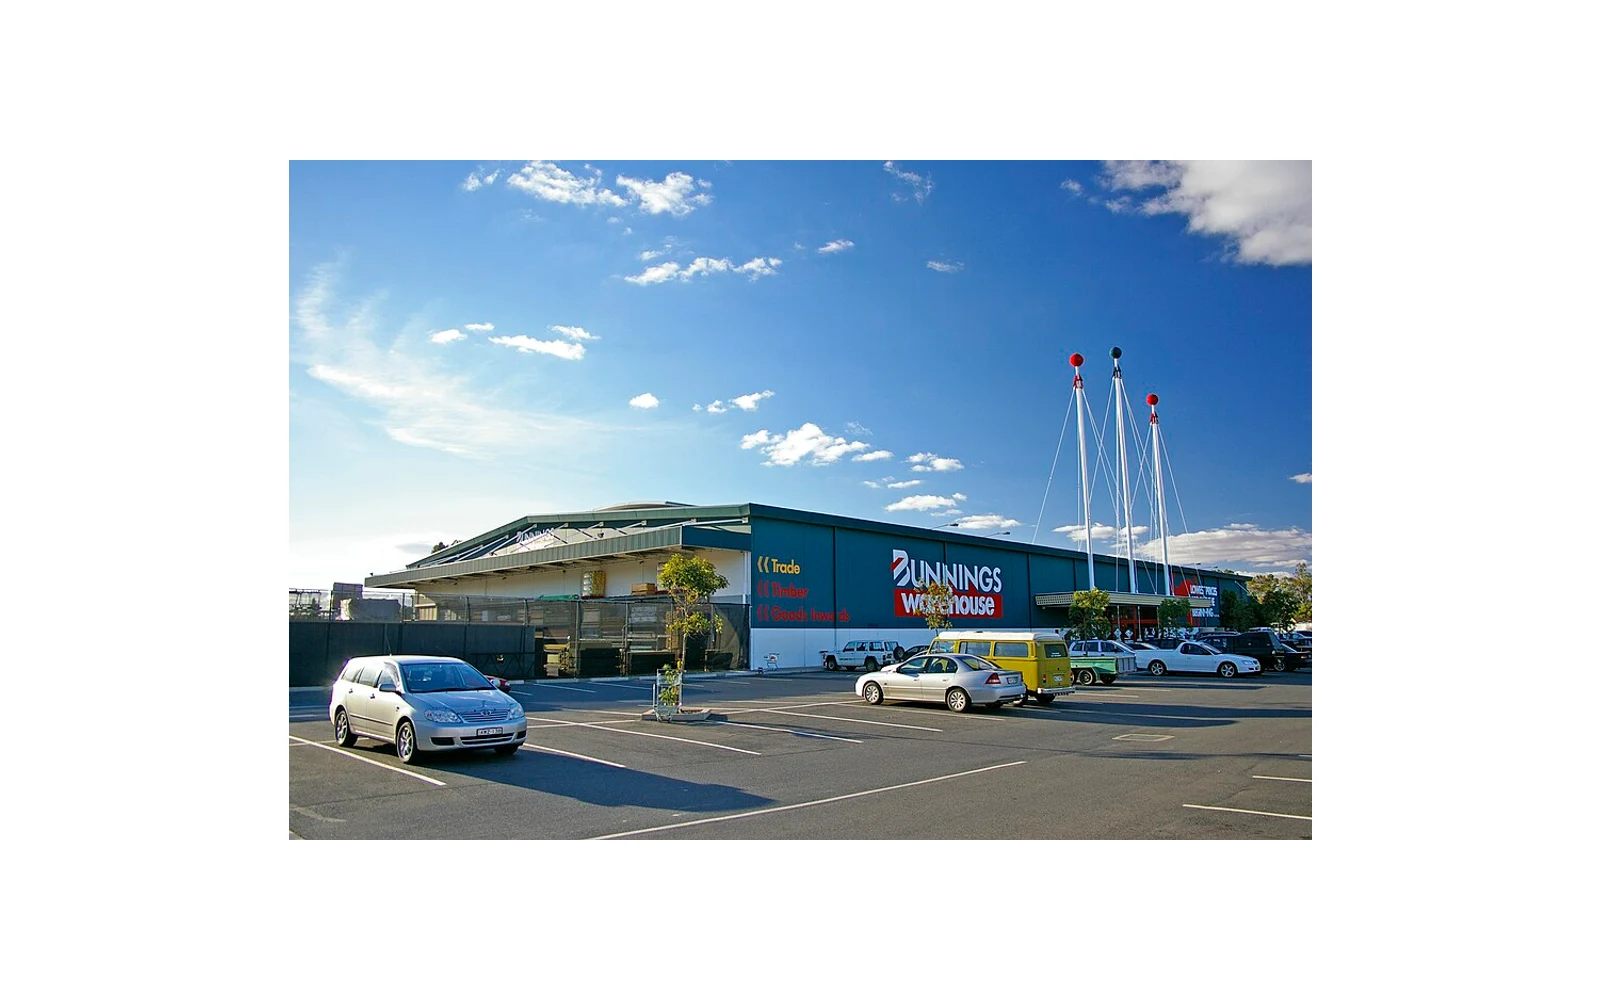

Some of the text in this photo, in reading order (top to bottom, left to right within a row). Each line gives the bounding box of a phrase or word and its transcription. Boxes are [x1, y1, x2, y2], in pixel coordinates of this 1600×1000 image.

[771, 558, 801, 575] Trade
[890, 549, 1002, 593] BUNNINGS
[771, 581, 809, 598] Timber
[771, 605, 807, 622] Goods
